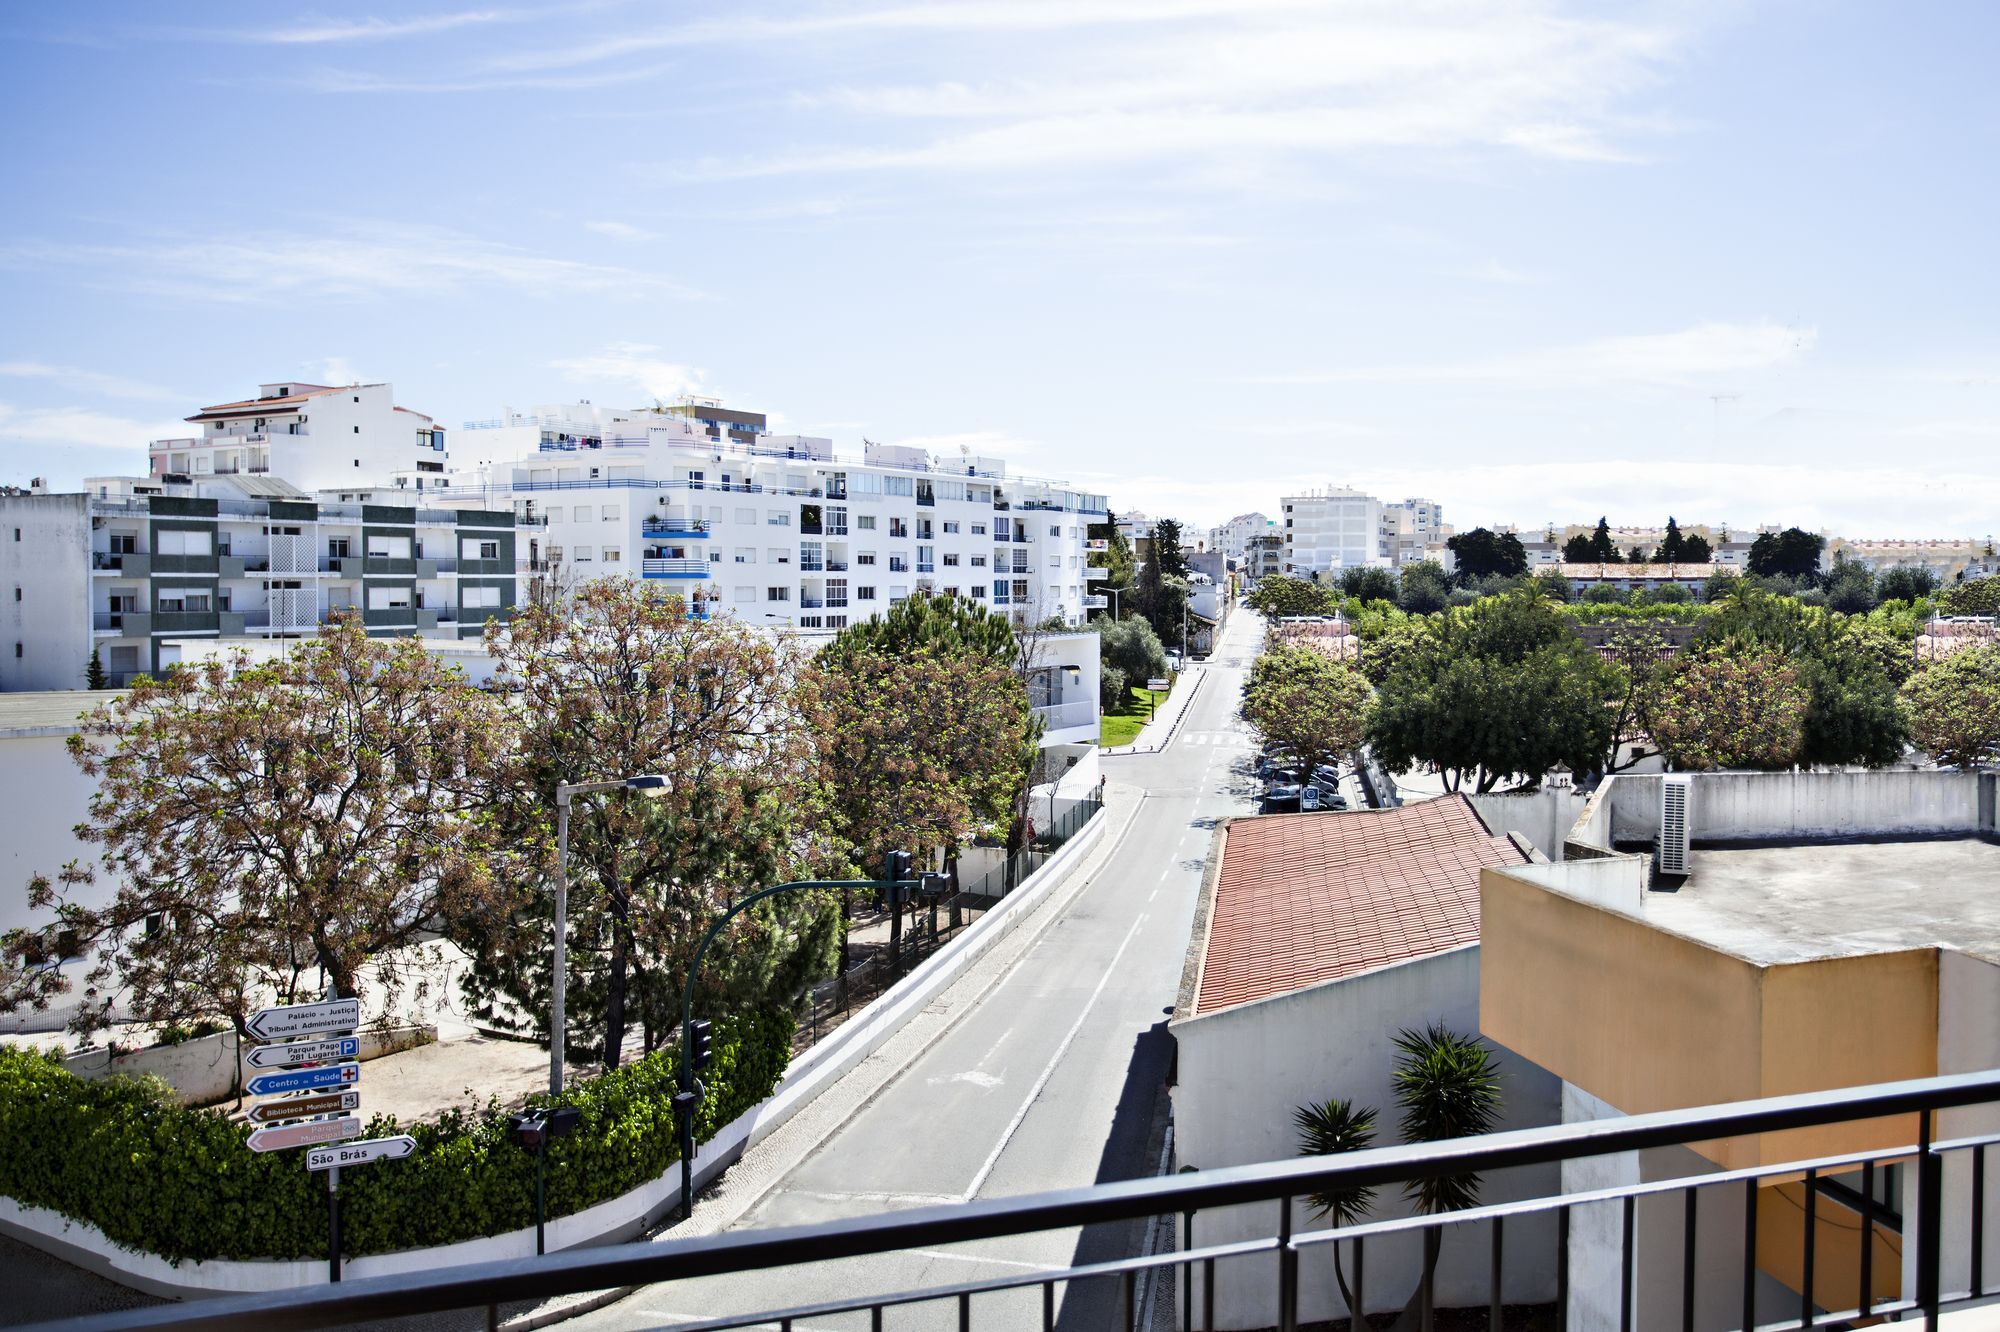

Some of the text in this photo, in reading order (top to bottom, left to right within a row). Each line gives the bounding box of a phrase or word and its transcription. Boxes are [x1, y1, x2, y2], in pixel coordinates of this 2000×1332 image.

[288, 1006, 356, 1020] Palácio Justiça
[268, 1017, 356, 1033] Tribunal Administrativo
[288, 1043, 340, 1054] Parque Pago
[308, 1050, 340, 1059] Lugares
[268, 1079, 299, 1088] Centro
[314, 1072, 340, 1082] Saúde
[266, 1100, 340, 1117] Biblioteca Municipal
[312, 1123, 341, 1133] Parque
[301, 1132, 341, 1142] Municipal
[311, 1150, 367, 1164] São Brás
